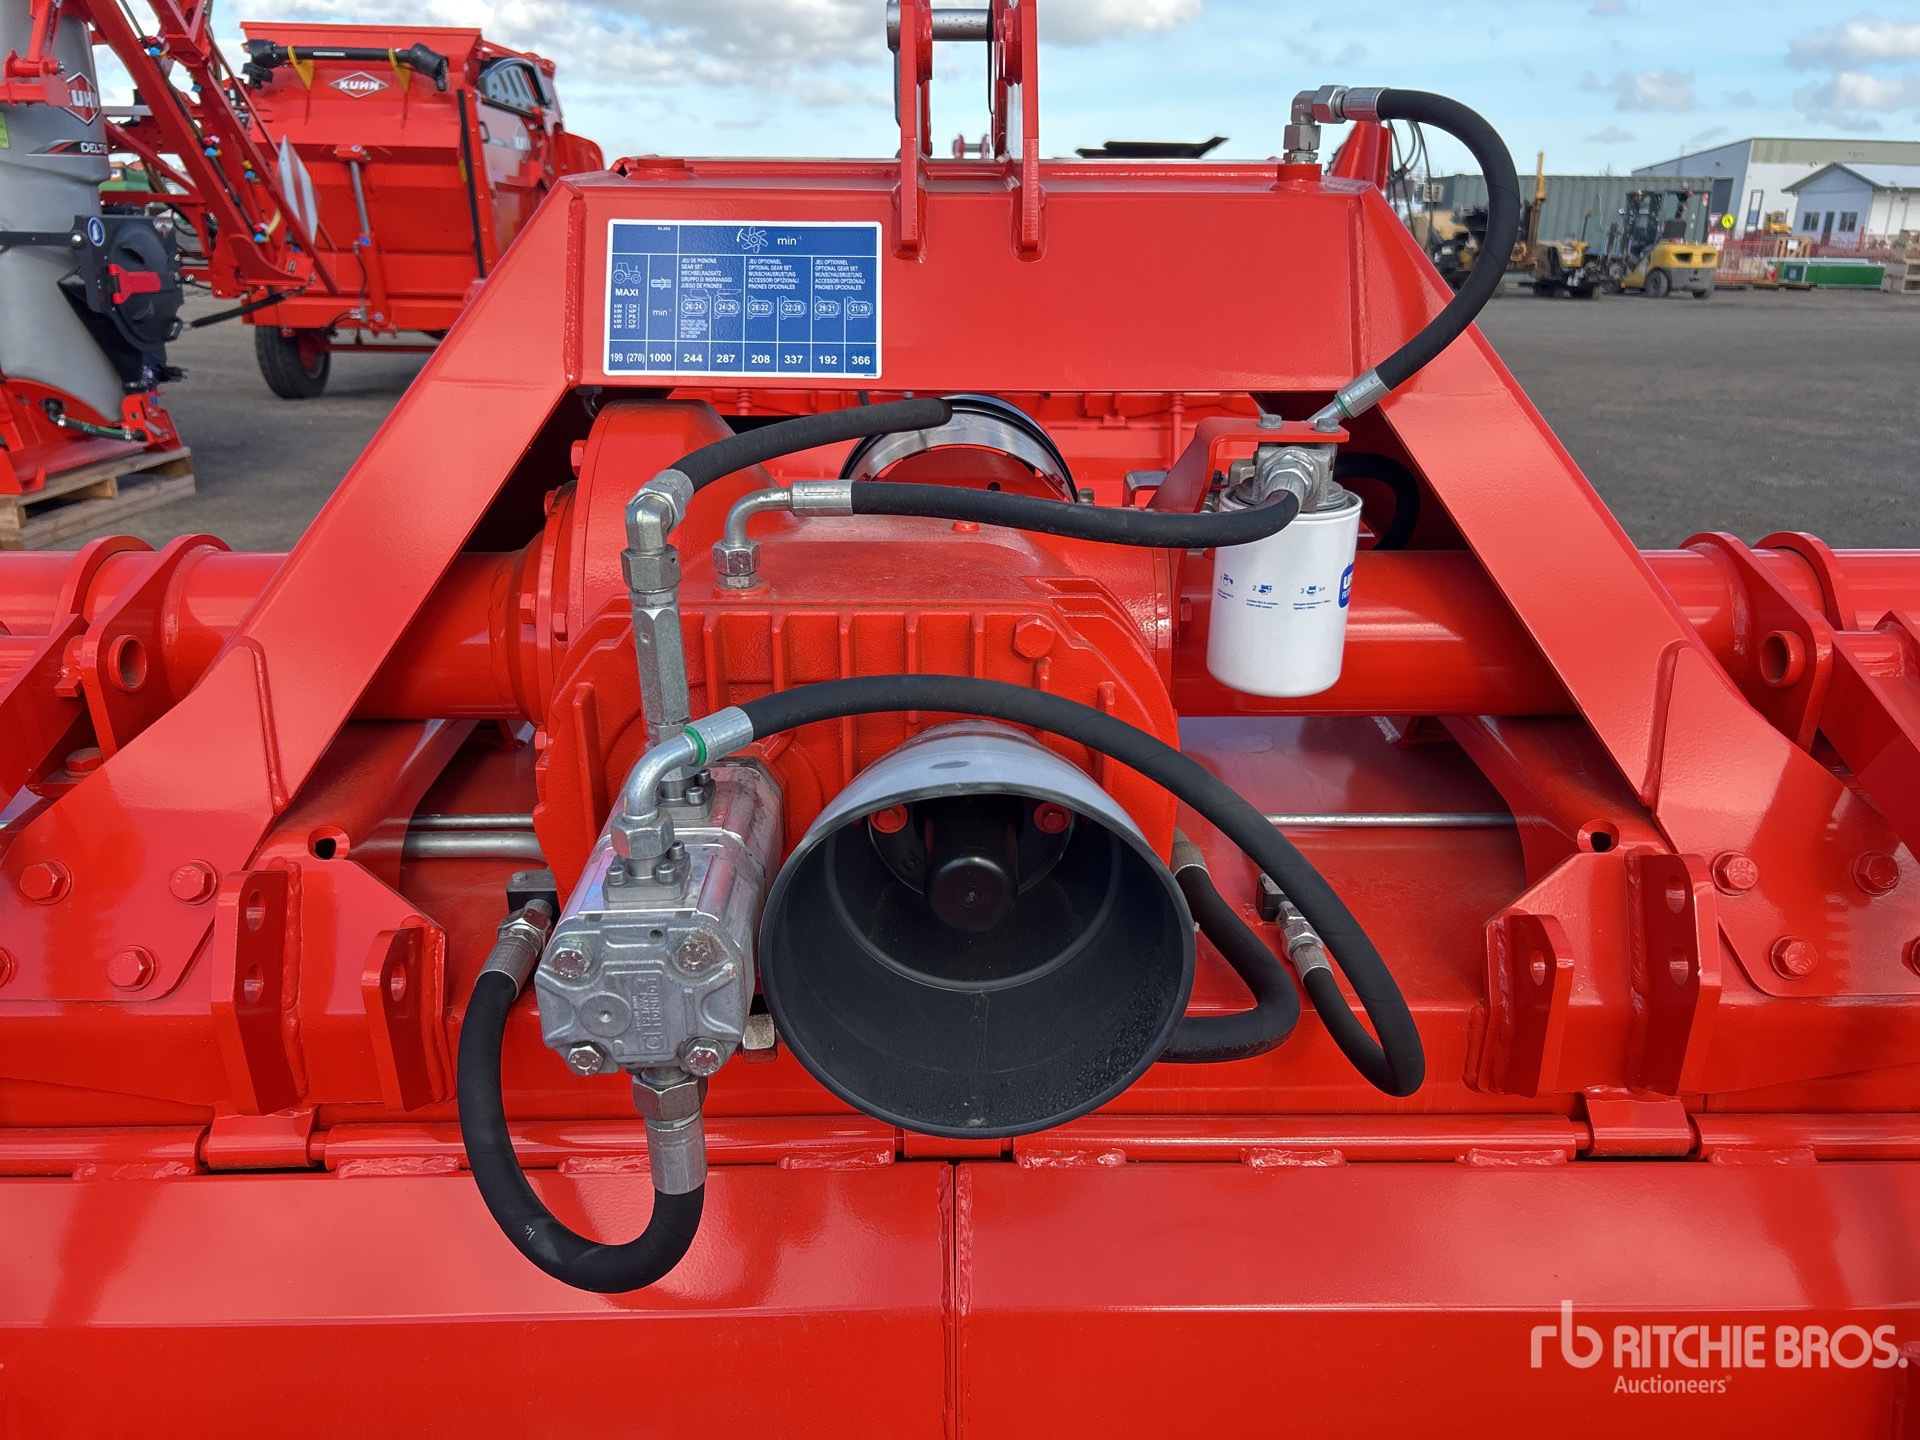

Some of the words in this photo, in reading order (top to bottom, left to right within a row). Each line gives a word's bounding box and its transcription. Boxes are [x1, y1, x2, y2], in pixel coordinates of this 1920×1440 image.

[339, 80, 379, 90] KUHN
[615, 288, 639, 296] MAXI
[610, 353, 623, 362] 199
[626, 353, 645, 364] (270)
[649, 353, 672, 362] 1000
[683, 354, 703, 363] 244
[716, 354, 736, 363] 287
[751, 355, 771, 364] 208
[784, 355, 803, 364] 337
[819, 356, 838, 364] 192
[851, 356, 871, 365] 366
